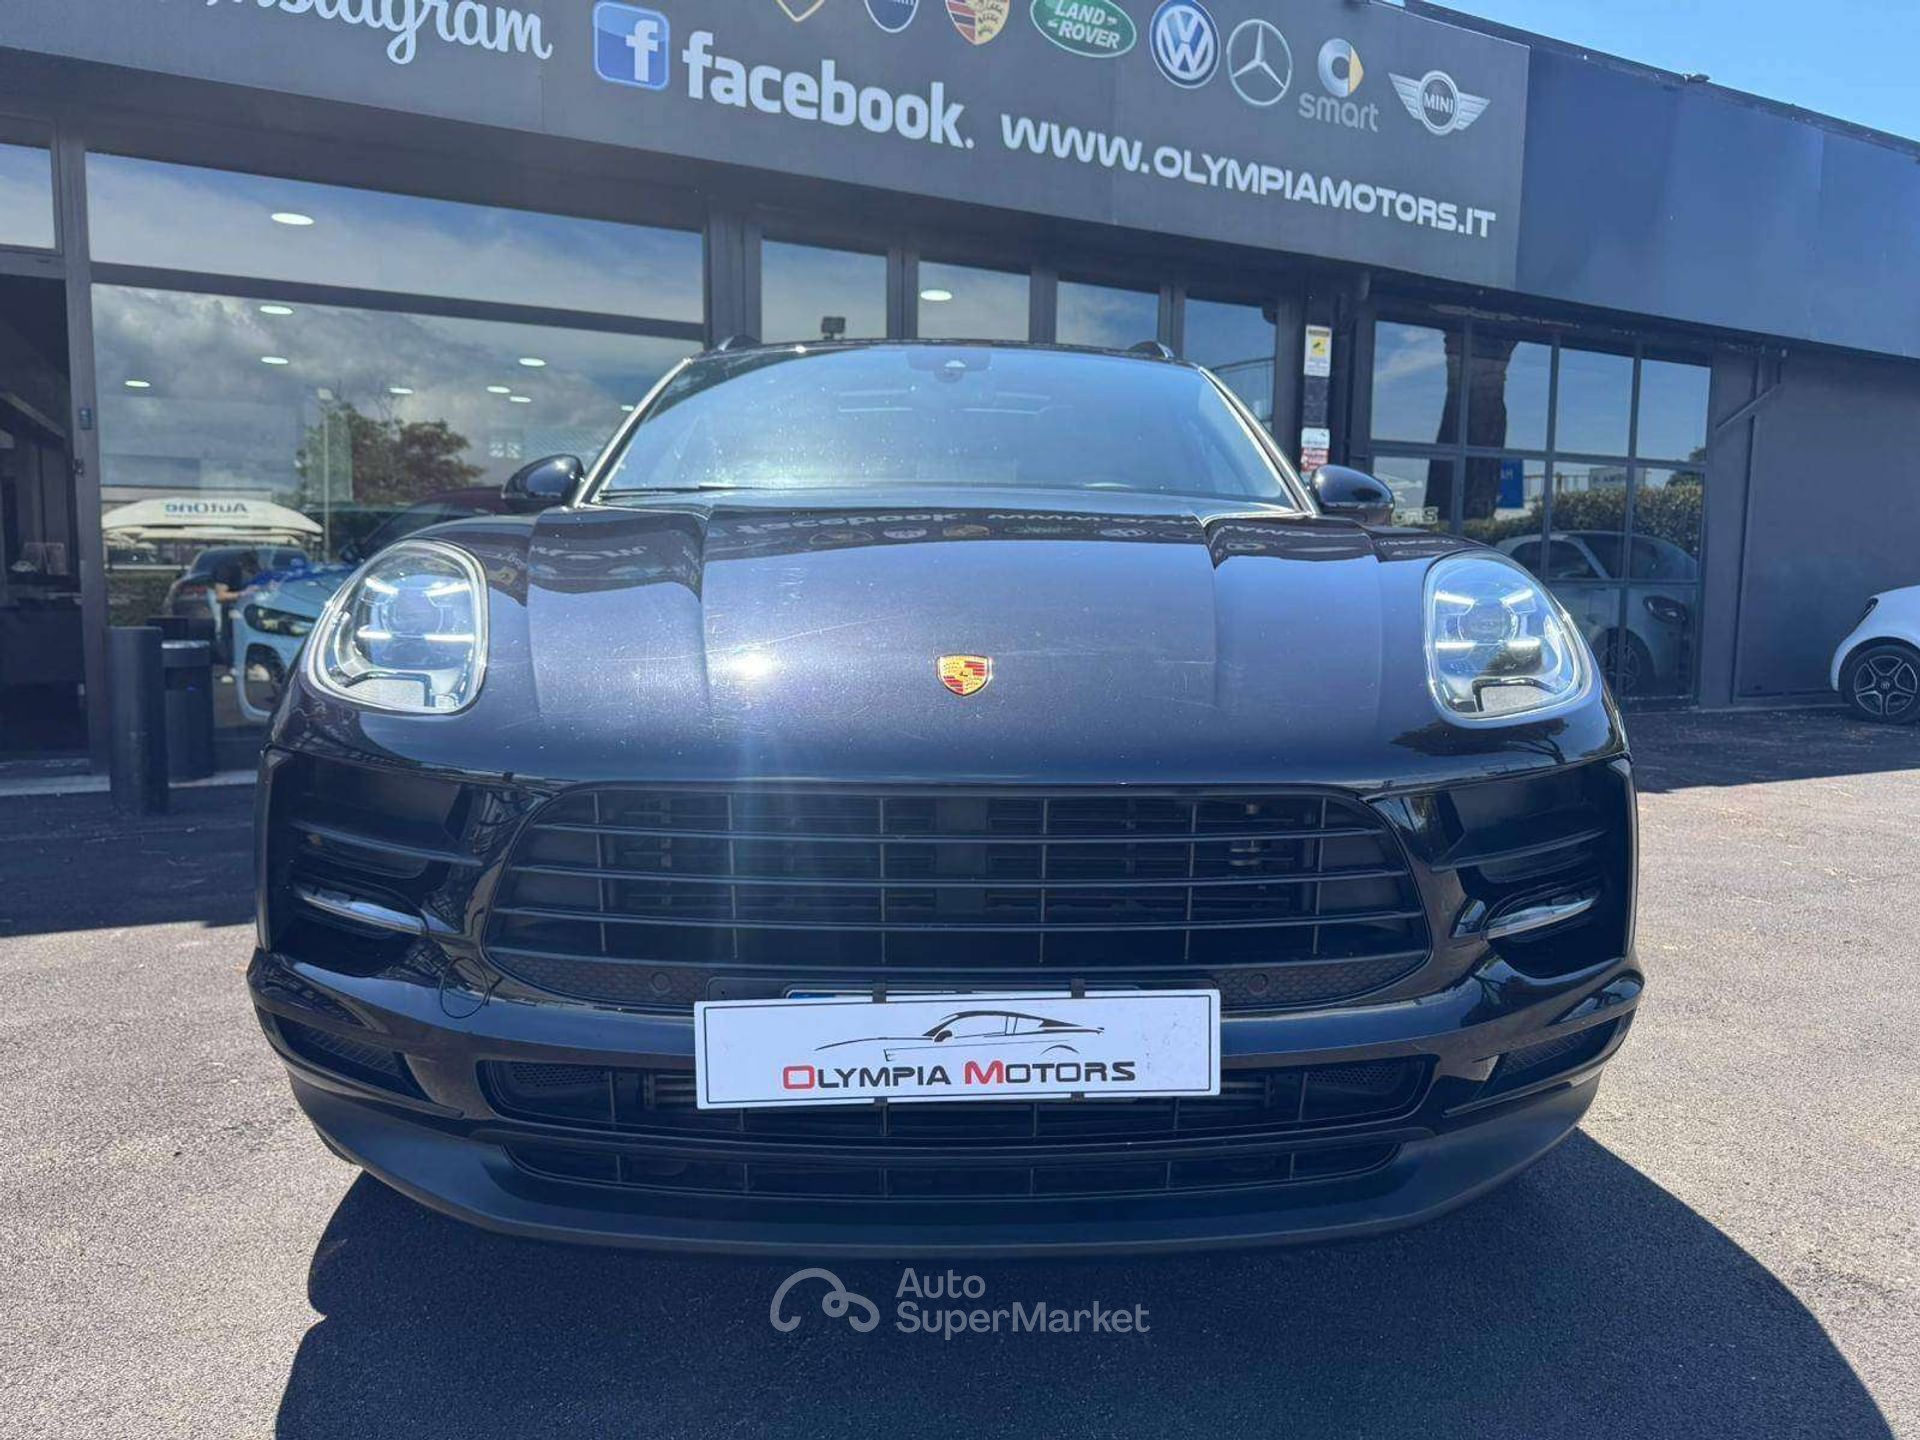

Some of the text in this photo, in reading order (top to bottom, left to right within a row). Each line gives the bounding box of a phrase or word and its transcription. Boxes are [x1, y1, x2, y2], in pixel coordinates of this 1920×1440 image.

[1054, 0, 1106, 25] LAND
[1058, 18, 1121, 50] ROVER
[682, 30, 975, 149] facebook.
[1423, 92, 1454, 114] MINI
[1298, 91, 1380, 133] smart
[782, 1060, 1137, 1090] OLYMPIA MOTORS
